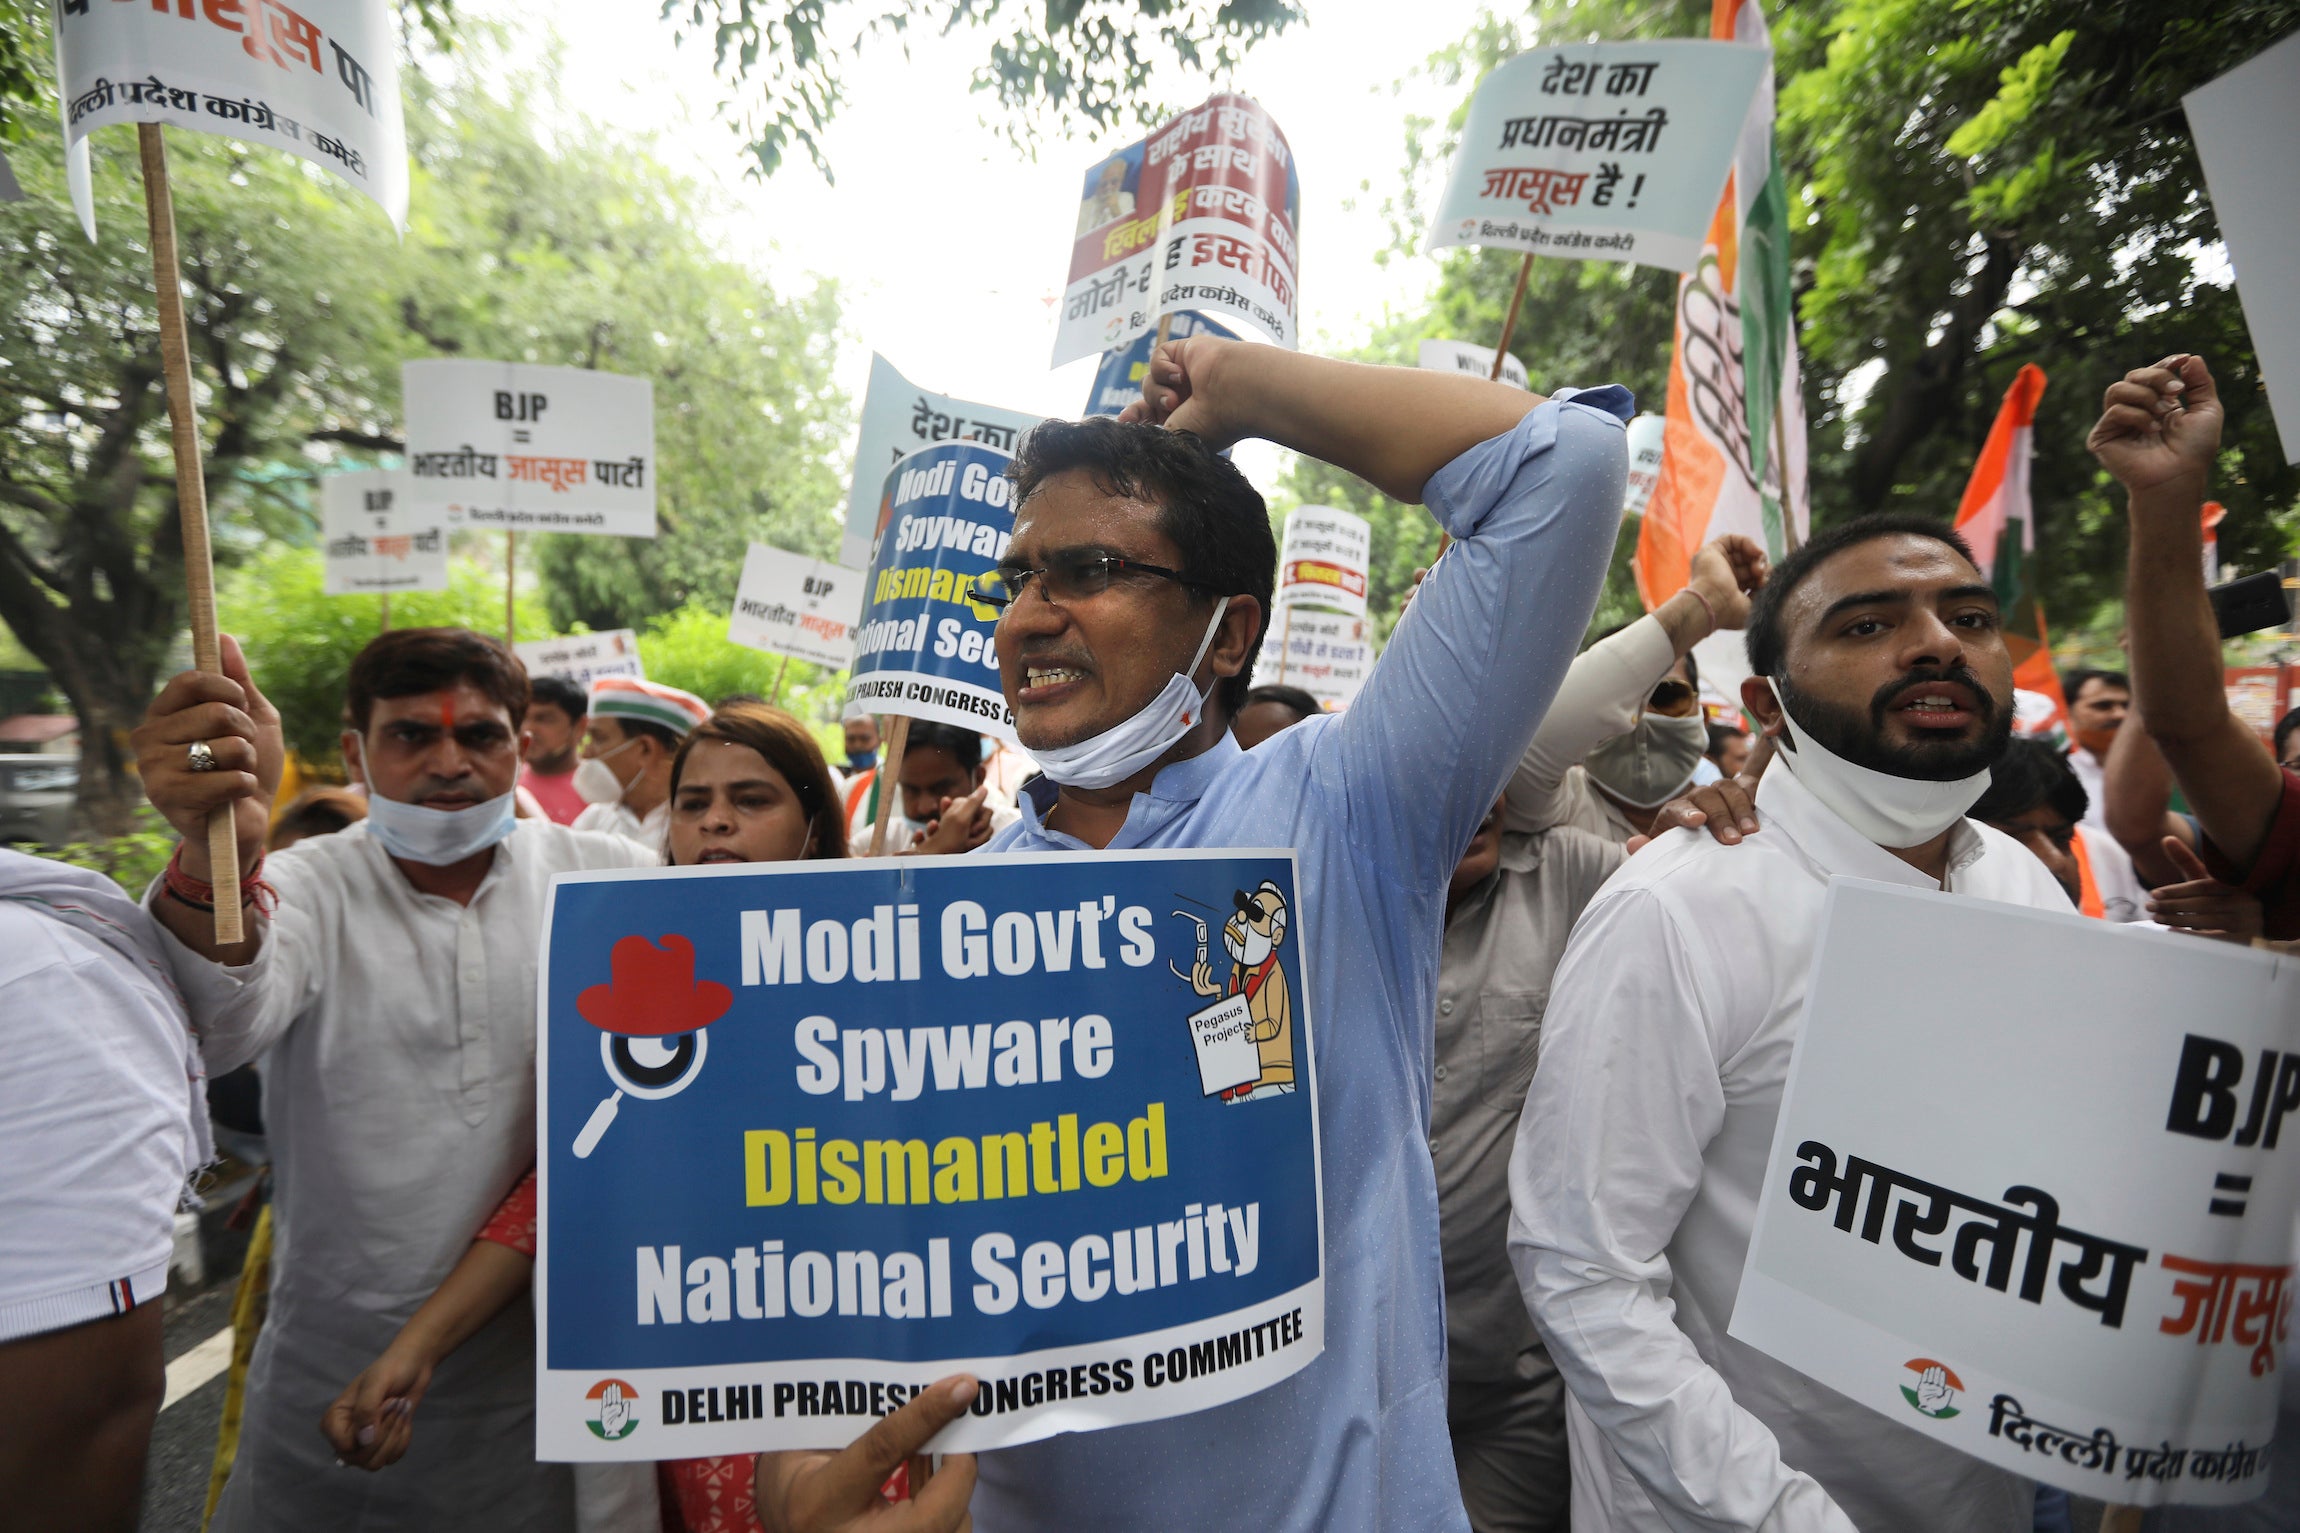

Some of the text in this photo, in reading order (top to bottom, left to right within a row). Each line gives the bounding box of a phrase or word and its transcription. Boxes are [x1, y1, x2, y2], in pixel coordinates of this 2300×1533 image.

[1541, 53, 1660, 96] देश का
[1498, 107, 1668, 152] प्रधानमंत्री
[1167, 144, 1259, 185] के साथ
[1480, 167, 1589, 215] जासूस
[1592, 162, 1623, 207] है
[1199, 281, 1250, 311] कांग्रेस
[494, 390, 548, 422] BJP
[912, 396, 966, 440] देश
[412, 445, 645, 491] भारतीय जासूस पार्टी
[895, 460, 957, 508] Modi
[803, 576, 834, 597] BJP
[855, 681, 904, 699] PRADESH
[906, 682, 1001, 721] CONGRESS
[739, 895, 1155, 986] Modi Govt's
[1194, 1005, 1244, 1032] Pegasus
[1203, 1021, 1244, 1047] Project
[794, 1014, 1114, 1101] Spyware
[2166, 1033, 2300, 1150] BJP
[744, 1102, 1169, 1208] Dismantled
[2208, 1172, 2253, 1217] =
[1788, 1140, 2149, 1329] भारतीय
[636, 1202, 1260, 1325] National Security
[662, 1382, 763, 1426] DELHI
[956, 1357, 1134, 1419] ONGRESS
[1142, 1308, 1304, 1389] COMMITTEE
[1987, 1393, 2126, 1476] दिल्ली
[2125, 1440, 2188, 1484] प्रदेश
